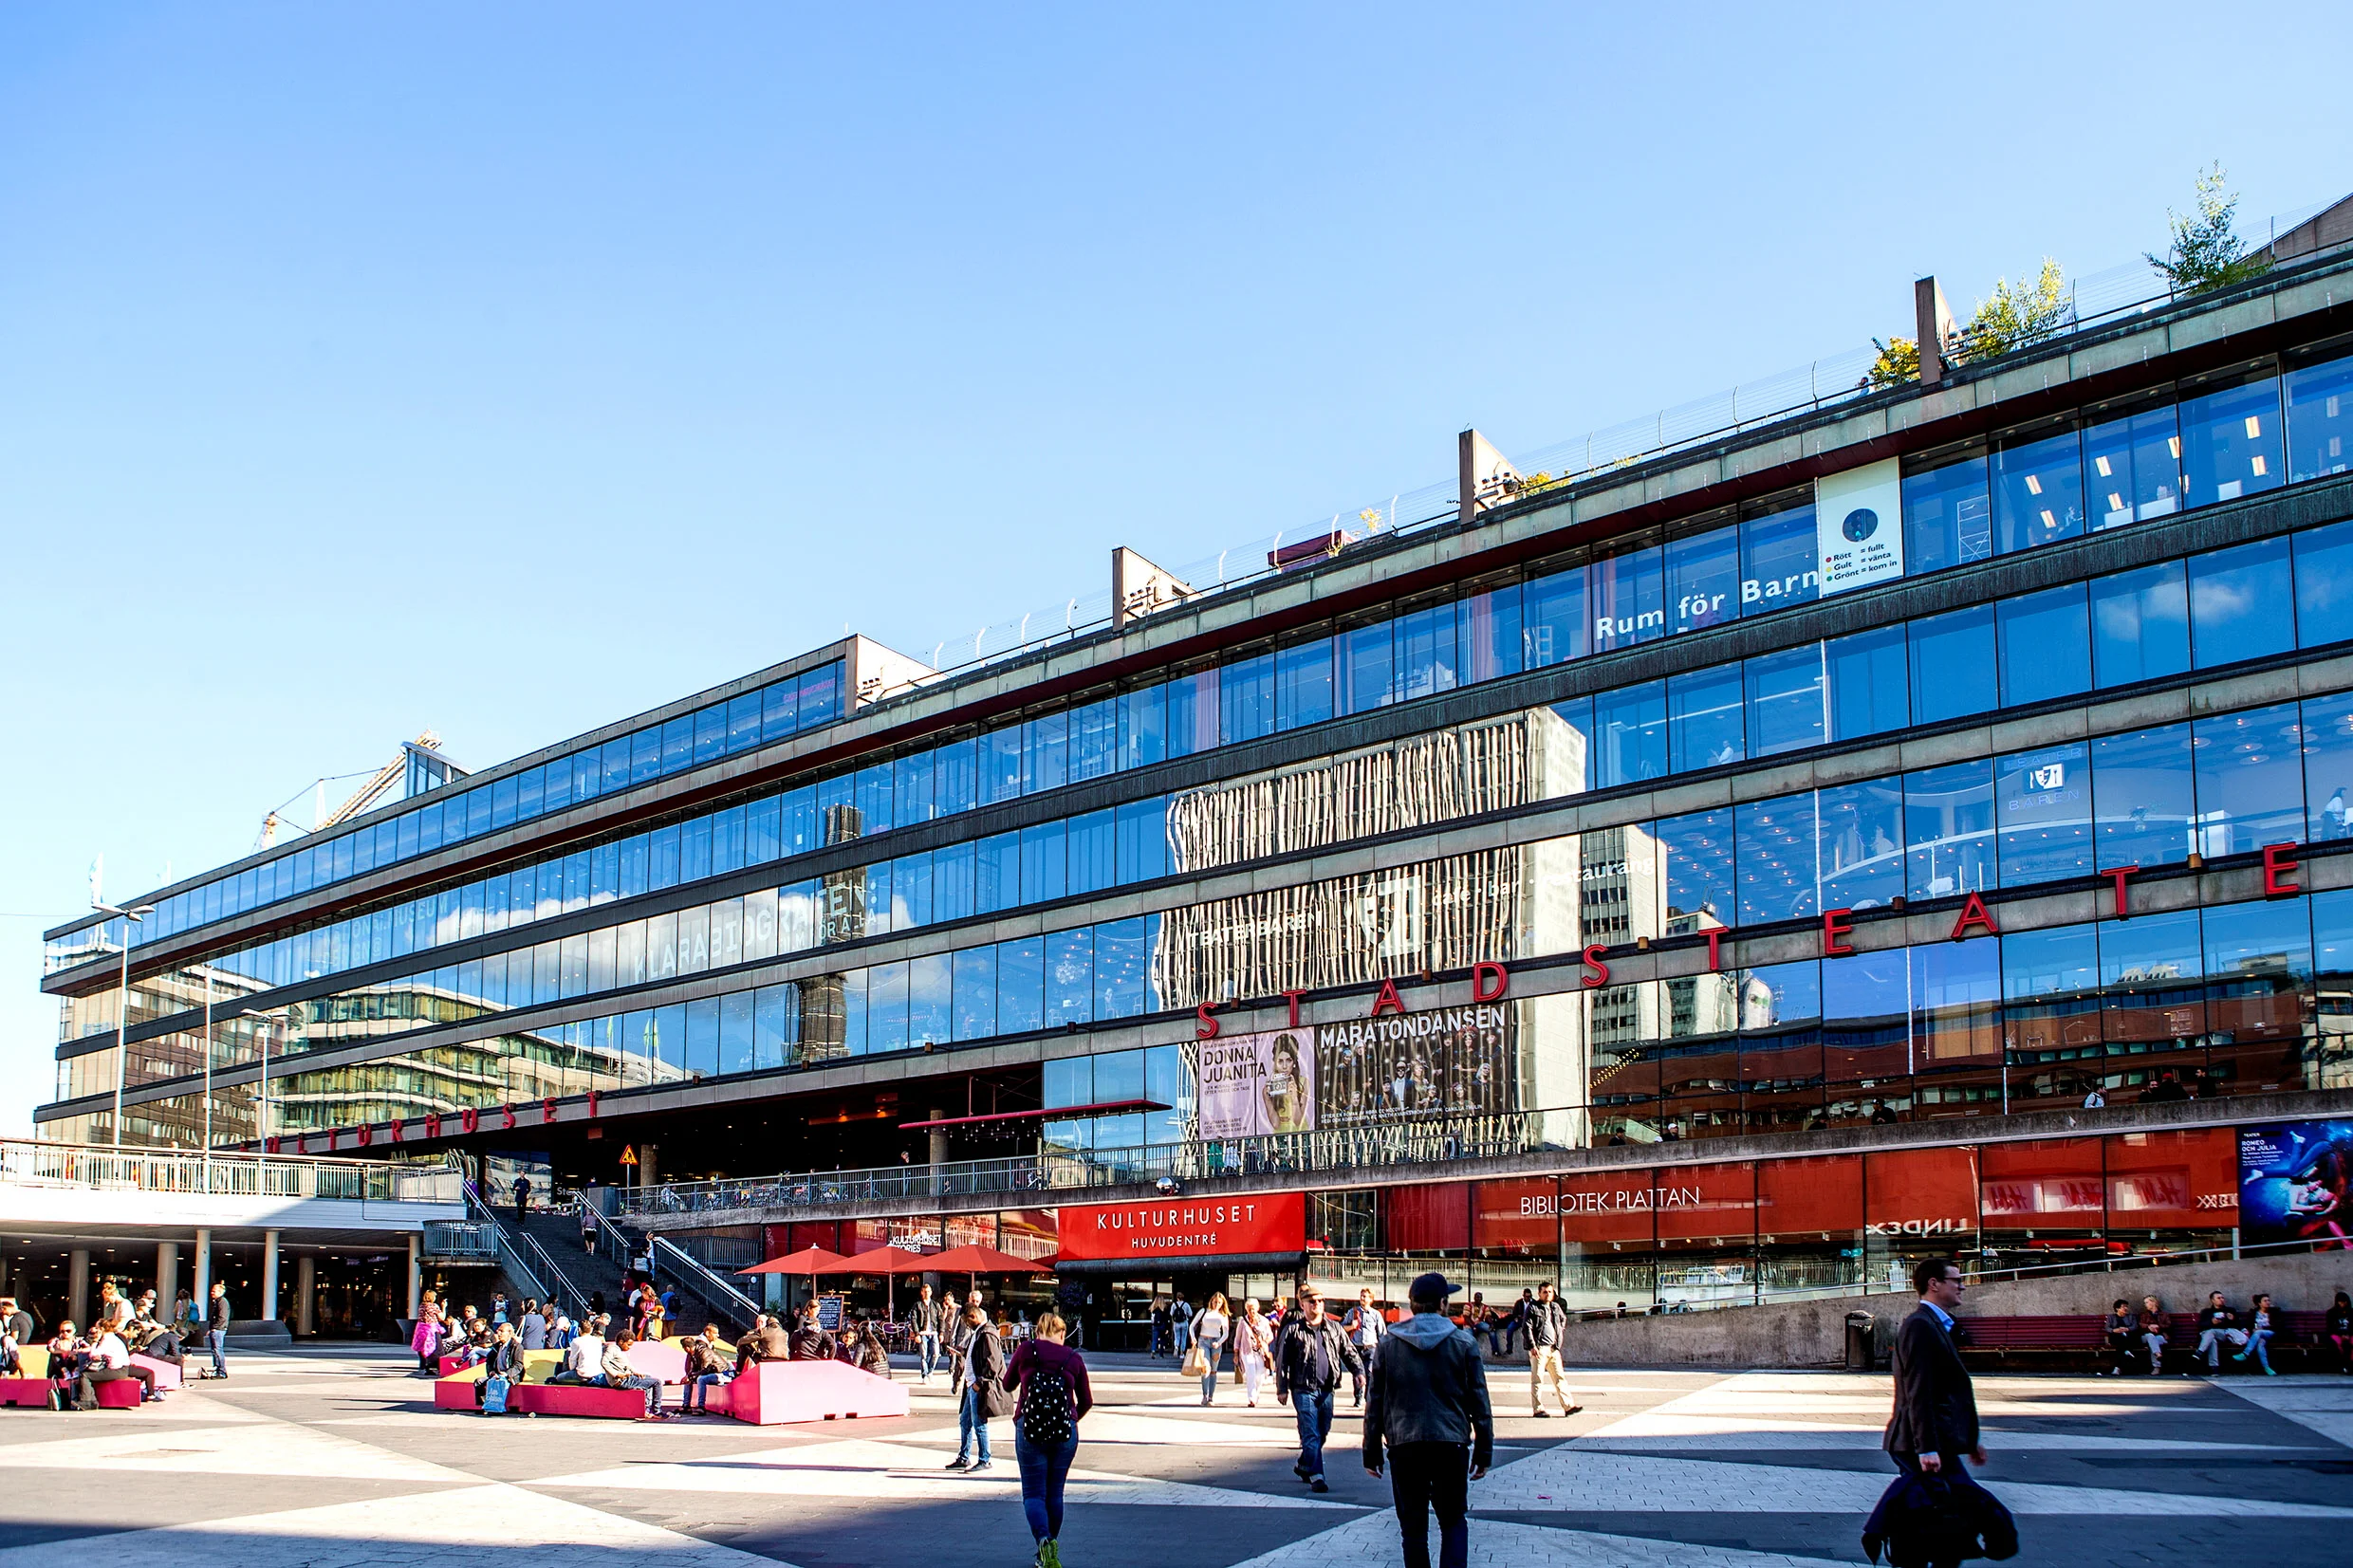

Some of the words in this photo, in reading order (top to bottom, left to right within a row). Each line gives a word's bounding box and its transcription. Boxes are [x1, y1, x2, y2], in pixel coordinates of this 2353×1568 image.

[1833, 552, 1852, 562] Rött
[1867, 544, 1884, 553] fullt
[1833, 562, 1852, 571] Gult
[1868, 552, 1891, 563] vänta
[1834, 569, 1859, 581] Grönt
[1868, 563, 1887, 572] kom
[1596, 608, 1663, 640] Rum
[1677, 593, 1725, 619] för
[1742, 569, 1819, 603] Barn
[2004, 747, 2082, 771] TEATER
[2009, 789, 2080, 811] BAREN
[1321, 1005, 1505, 1049] MARATONDANSEN
[1204, 1046, 1254, 1066] DONNA
[1204, 1062, 1268, 1083] JUANITA
[1520, 1191, 1609, 1215] BIBLIOTEK
[1616, 1186, 1699, 1209] PLATTAN
[1097, 1205, 1255, 1230] KULTURHUSET
[893, 1233, 941, 1245] KULTURHUSET
[1131, 1231, 1217, 1248] HUVUDENTRÉ
